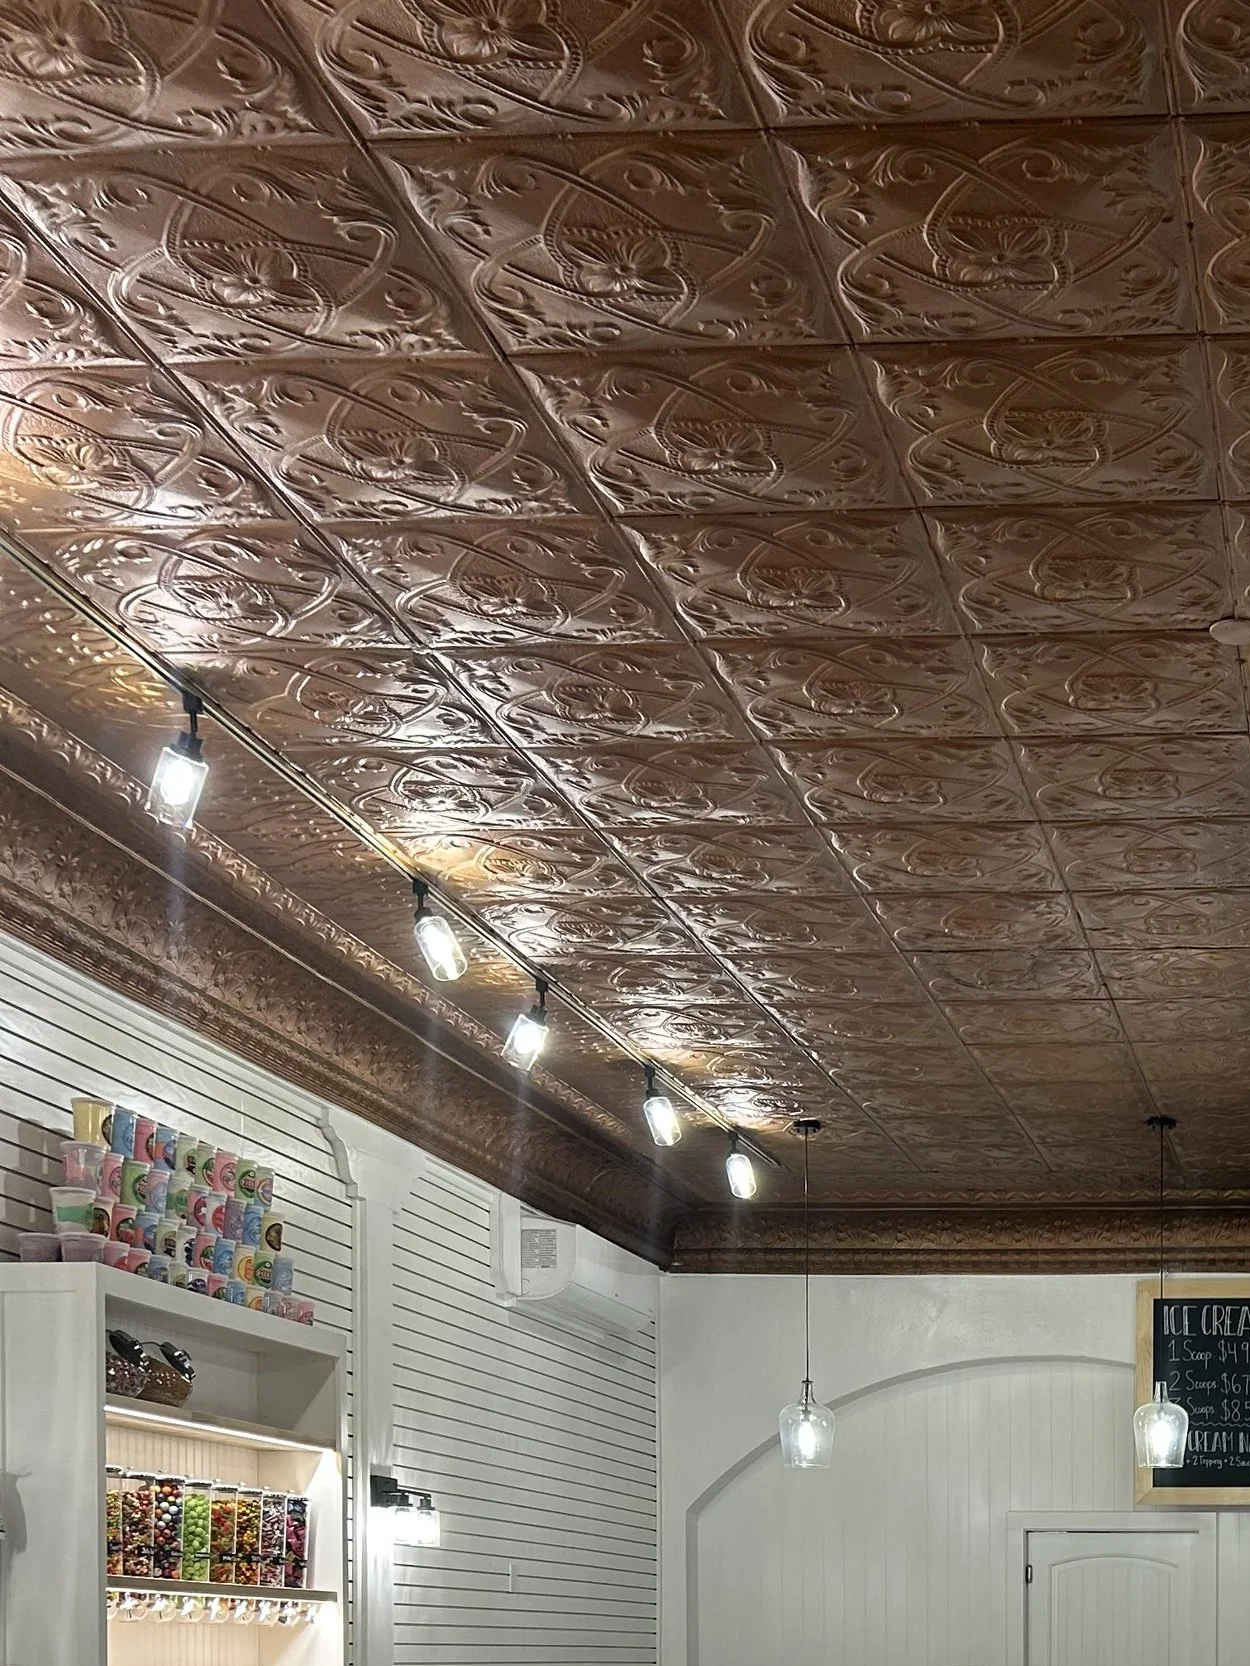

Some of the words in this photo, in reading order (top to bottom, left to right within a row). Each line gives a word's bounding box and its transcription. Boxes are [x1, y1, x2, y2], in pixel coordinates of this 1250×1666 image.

[1163, 1305, 1198, 1336] ICE
[1168, 1339, 1180, 1362] 1
[1182, 1339, 1213, 1370] Scoop
[1168, 1370, 1180, 1391] 2
[1185, 1369, 1217, 1396] Scoops
[1186, 1396, 1215, 1420] Scoops
[1187, 1430, 1234, 1453] CREAM
[1192, 1455, 1199, 1466] 2
[1229, 1456, 1235, 1467] 2
